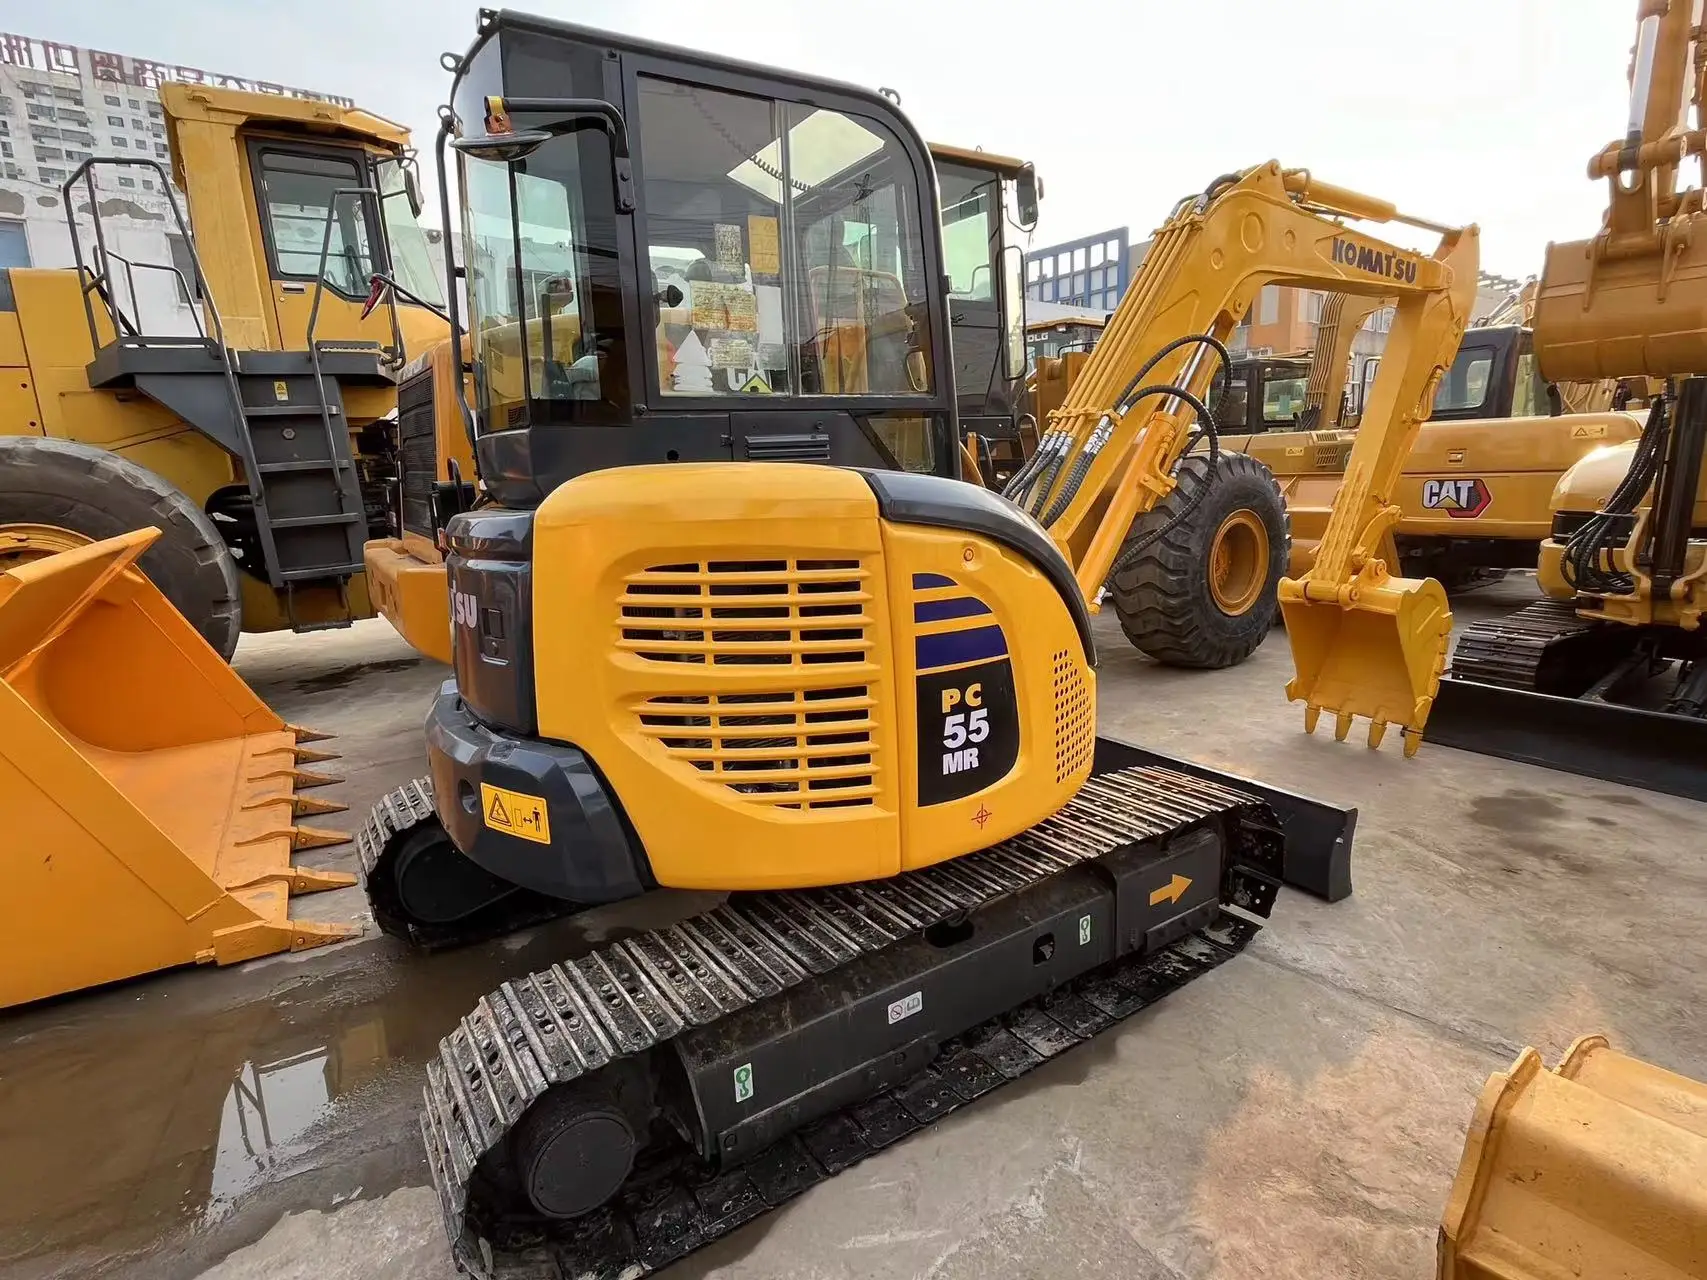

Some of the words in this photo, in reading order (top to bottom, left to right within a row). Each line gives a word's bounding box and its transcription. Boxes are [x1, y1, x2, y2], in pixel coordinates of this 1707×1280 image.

[1332, 236, 1417, 284] KOMATSU
[1423, 480, 1474, 508] CAT
[942, 683, 982, 713] PC
[943, 708, 990, 749] 55
[943, 747, 980, 775] MR
